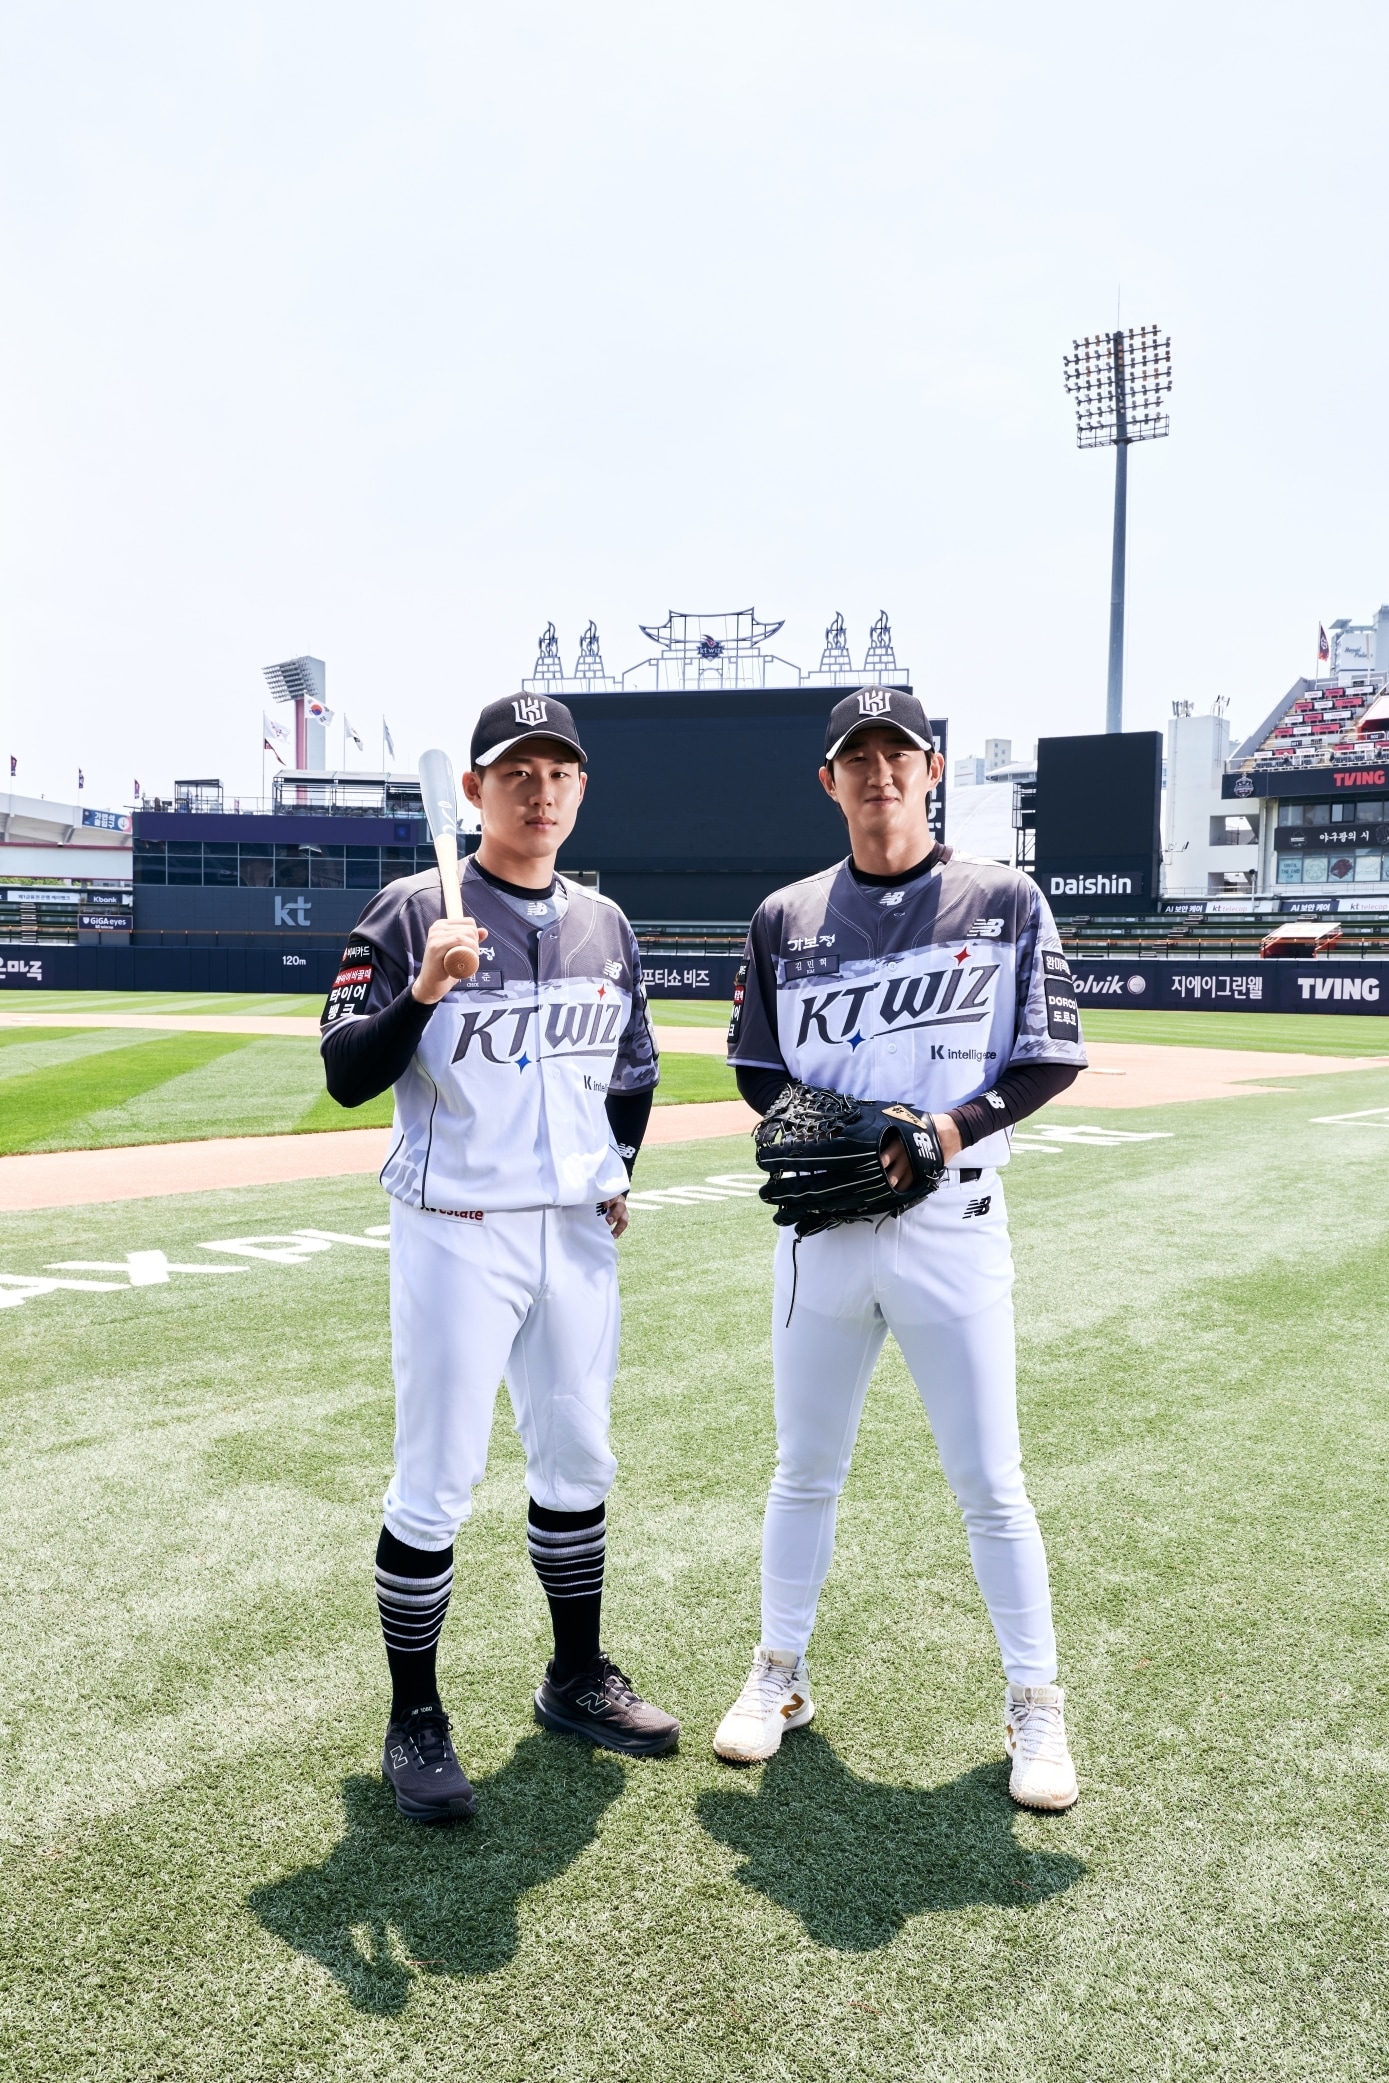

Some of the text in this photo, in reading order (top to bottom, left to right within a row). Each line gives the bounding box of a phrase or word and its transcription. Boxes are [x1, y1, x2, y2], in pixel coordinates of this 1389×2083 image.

[1334, 770, 1386, 786] TVING
[1319, 830, 1370, 843] 야구광의 시
[1050, 874, 1132, 895] Daishin
[275, 895, 311, 926] kt
[787, 933, 836, 951] 가보정
[329, 984, 367, 1003] 타이어
[1171, 976, 1263, 999] 지에이그린웰
[1297, 977, 1380, 1001] TVING
[796, 982, 881, 1049] KT
[1053, 1010, 1077, 1026] 도루코
[451, 1004, 543, 1065] KT
[930, 1045, 945, 1060] K
